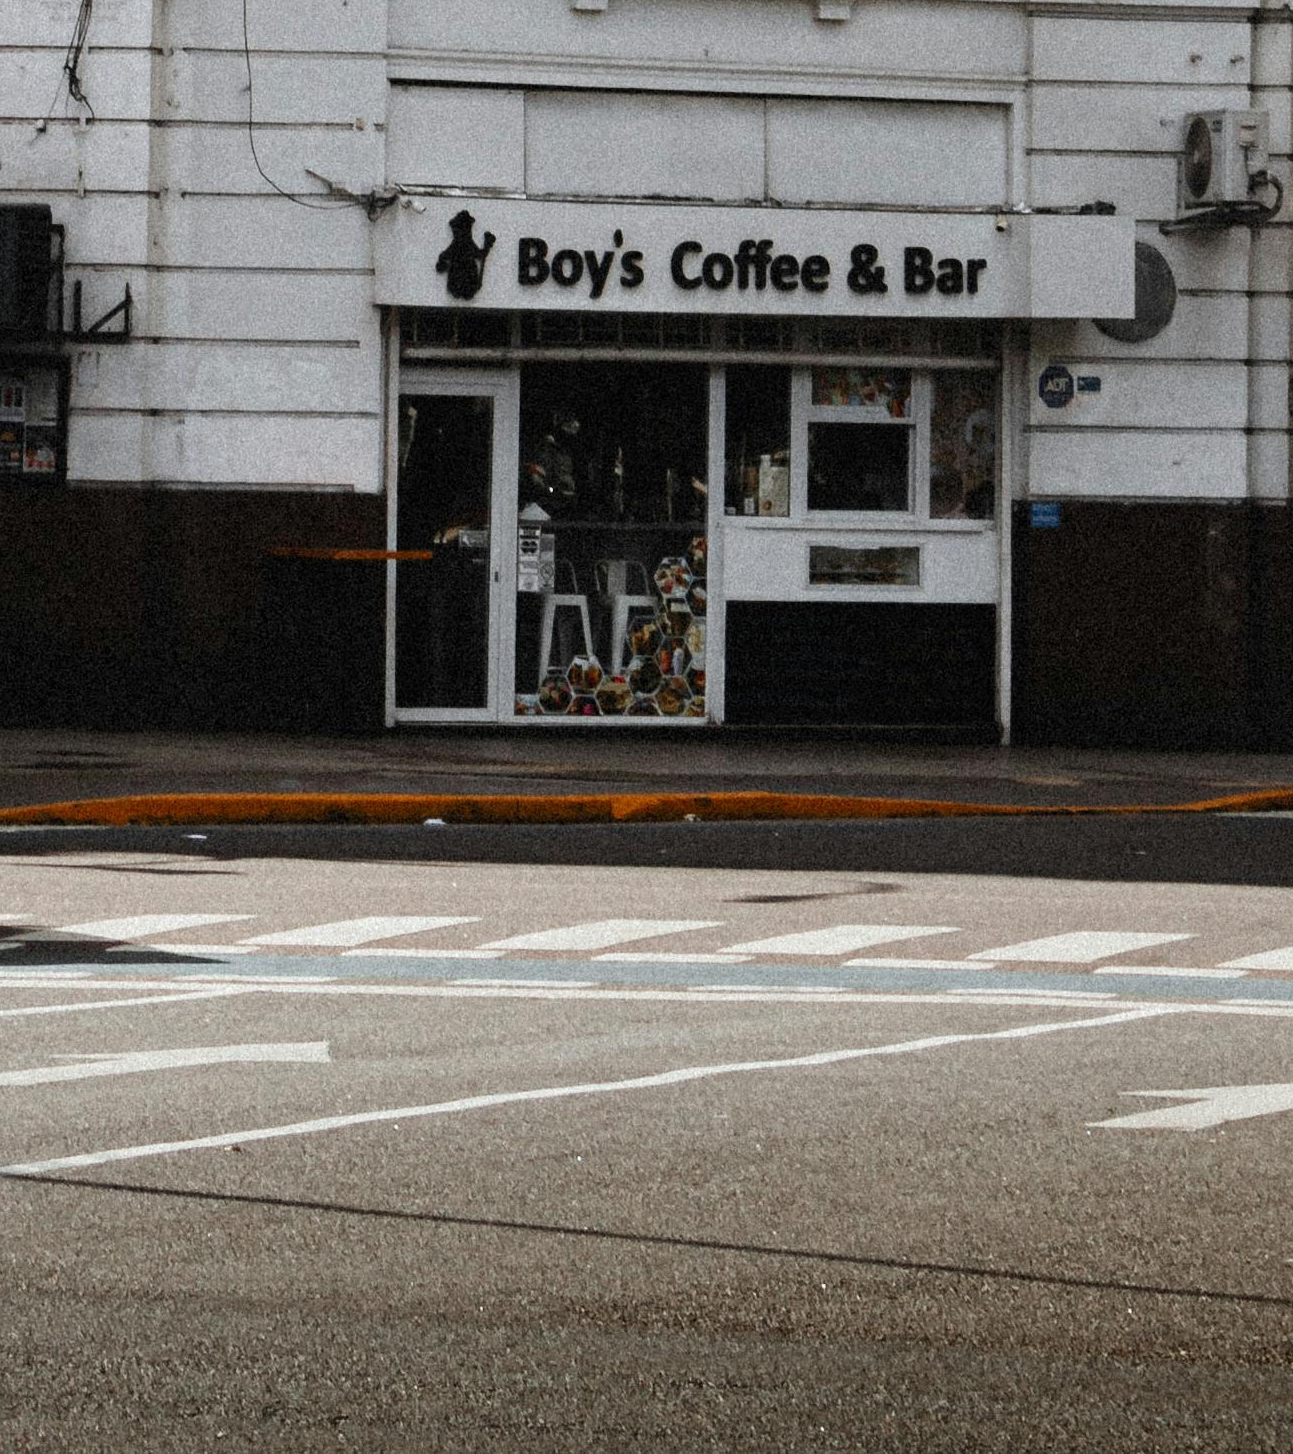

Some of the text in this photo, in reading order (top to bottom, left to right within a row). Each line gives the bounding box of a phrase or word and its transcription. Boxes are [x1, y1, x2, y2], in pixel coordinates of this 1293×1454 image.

[517, 228, 988, 300] Boy's Coffee & Bar
[1044, 377, 1069, 392] ADT
